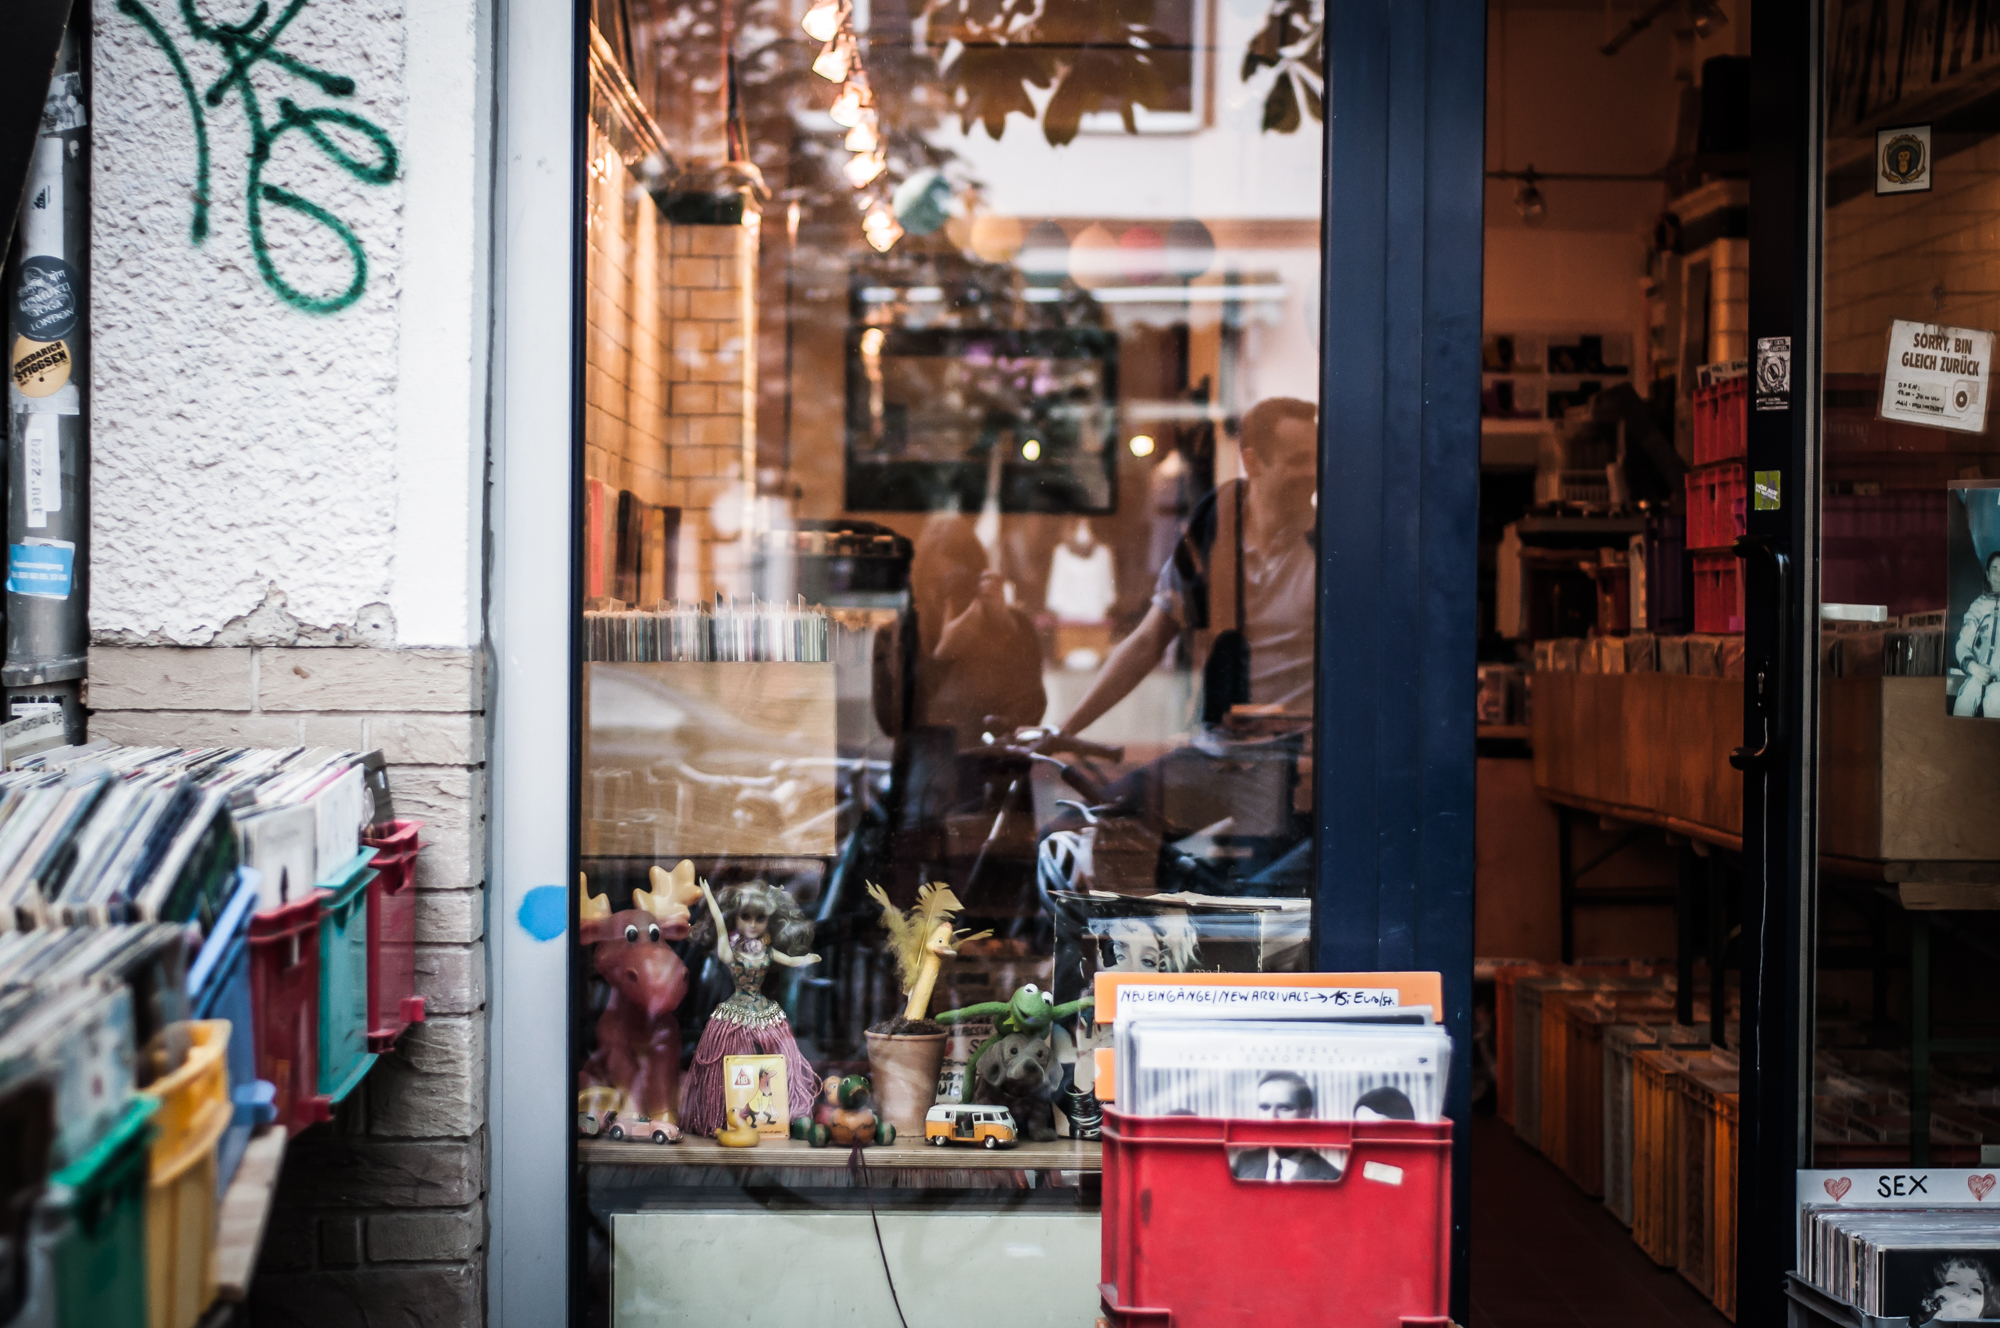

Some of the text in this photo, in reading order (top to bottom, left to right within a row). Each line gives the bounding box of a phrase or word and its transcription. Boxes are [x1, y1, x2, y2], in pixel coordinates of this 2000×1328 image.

[30, 307, 75, 331] LONDON
[1913, 332, 1972, 355] SORRY, BIN
[14, 350, 68, 381] STIGGSEN
[1901, 351, 1980, 376] GLEICH ZURÜCK
[31, 438, 42, 515] bzzz.net
[1178, 1053, 1403, 1065] TRANS EUROPA EXPRESS
[1239, 1045, 1341, 1055] KRAFTWERK
[737, 1075, 748, 1084] HB
[1877, 1175, 1928, 1198] SEX
